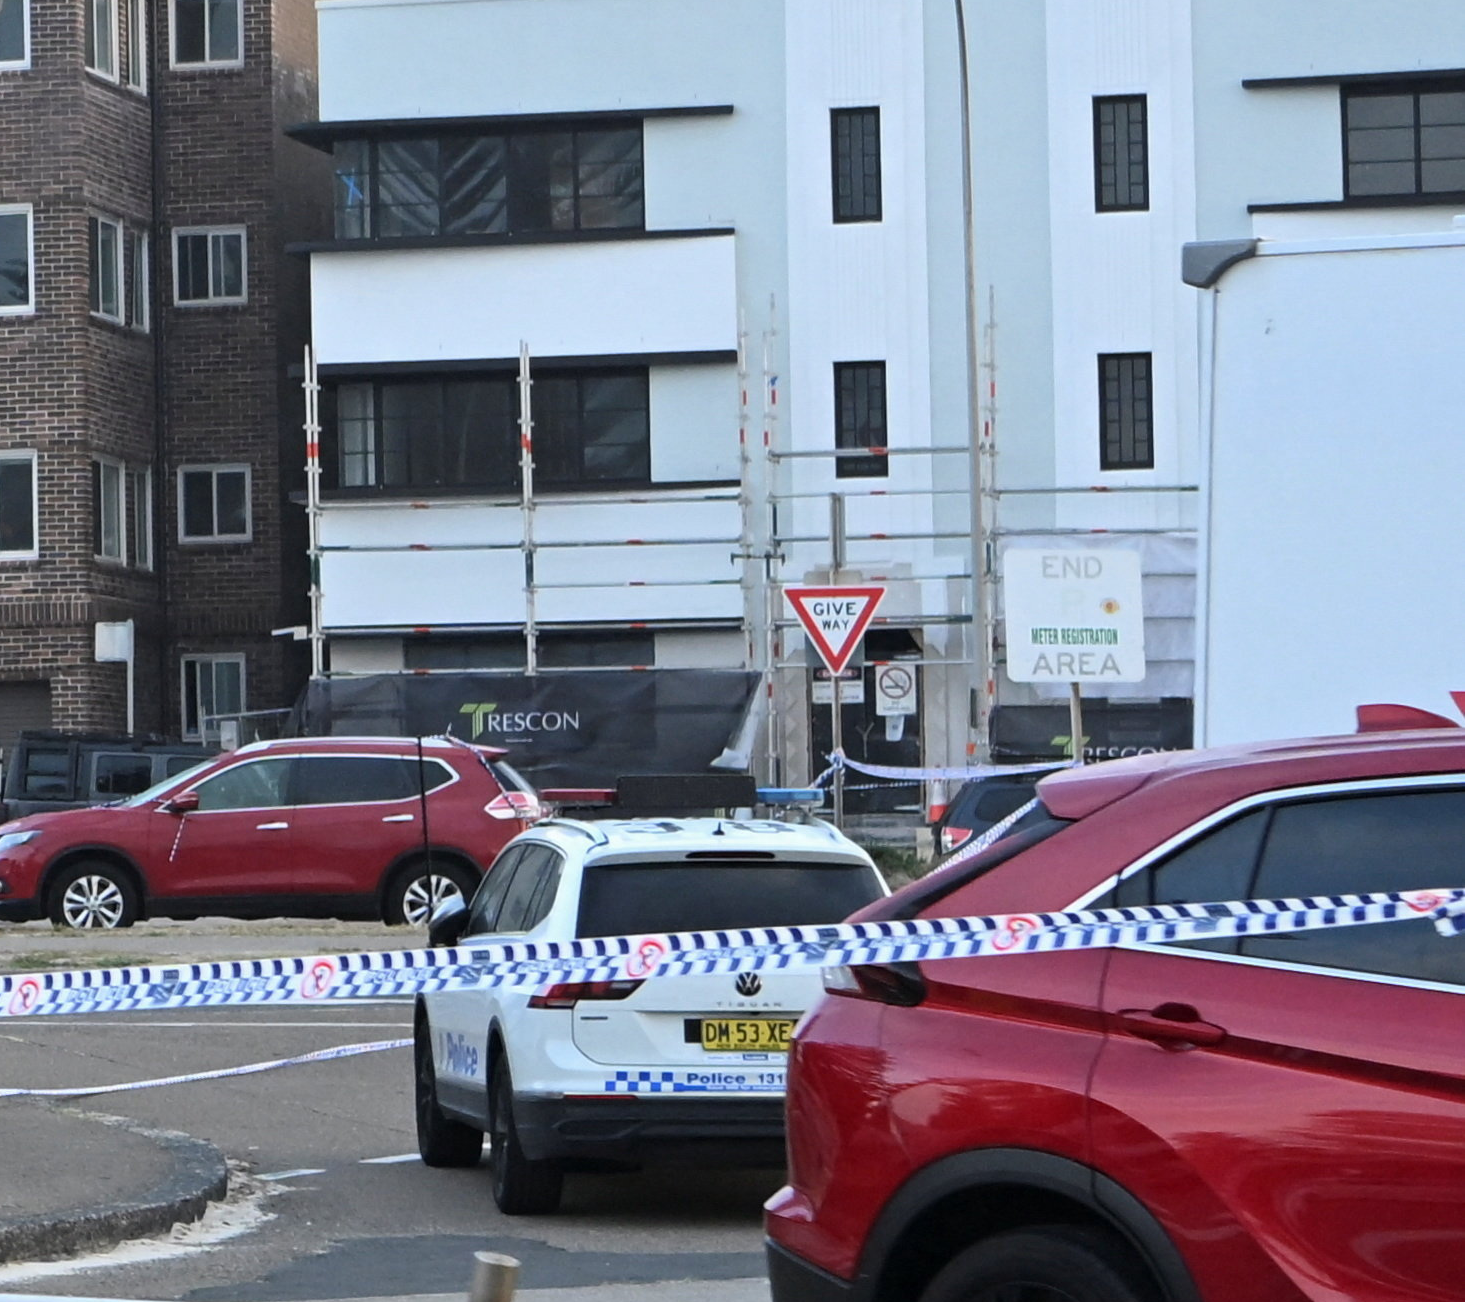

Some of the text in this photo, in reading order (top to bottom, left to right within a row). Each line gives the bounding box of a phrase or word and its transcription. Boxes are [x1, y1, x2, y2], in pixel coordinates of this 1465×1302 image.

[1041, 555, 1103, 579] END
[813, 601, 857, 616] GIVE
[822, 619, 850, 631] WAY
[1031, 627, 1119, 645] METER REGISTRATION
[1032, 652, 1122, 675] AREA
[686, 1072, 784, 1084] Police 131
